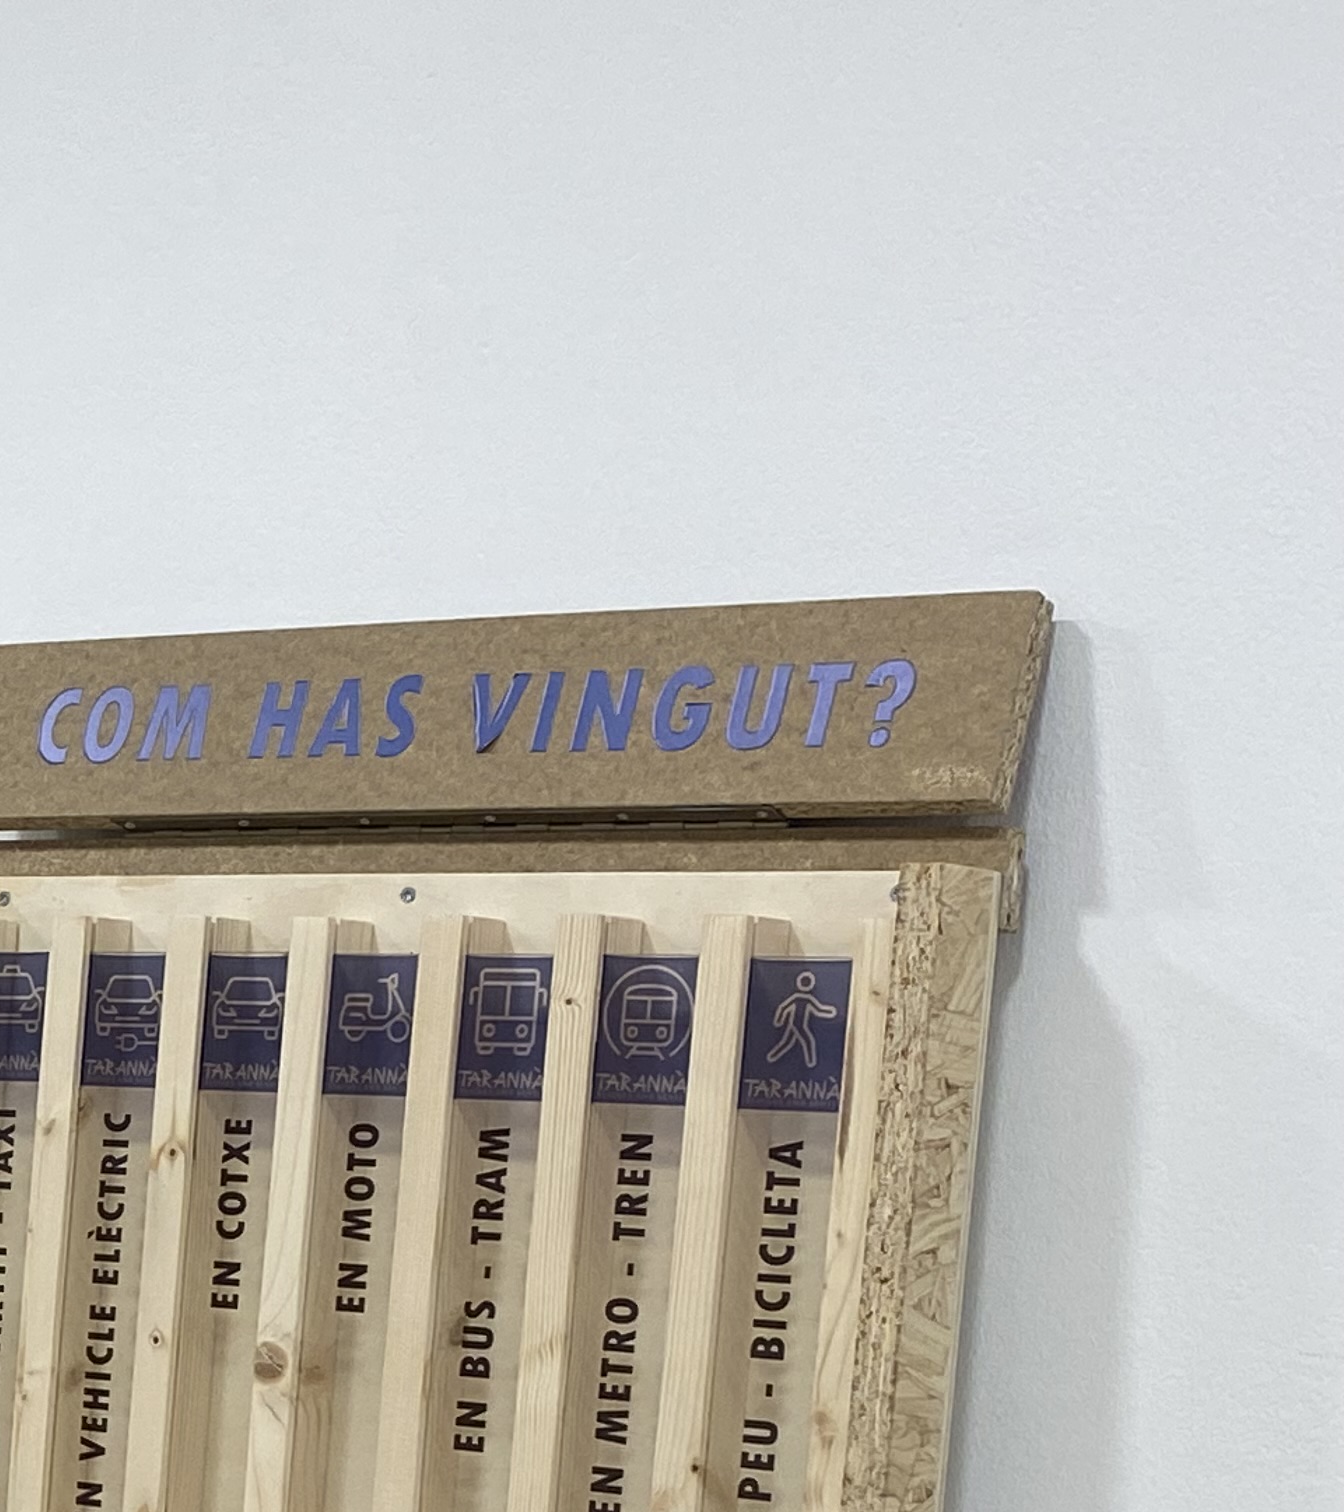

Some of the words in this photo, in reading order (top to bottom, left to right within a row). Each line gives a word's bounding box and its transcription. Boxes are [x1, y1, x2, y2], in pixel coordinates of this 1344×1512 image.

[35, 682, 214, 767] COM
[248, 671, 426, 761] HAS
[470, 656, 919, 755] VINGUT?
[743, 1076, 842, 1101] TARANNÀ
[86, 1111, 132, 1286] ELÈCTRIC
[215, 1117, 254, 1241] COTXE
[340, 1121, 381, 1242] MOTO
[470, 1126, 512, 1246] TRAM
[611, 1132, 654, 1243] TREN
[210, 1260, 242, 1310] EN
[335, 1263, 368, 1314] EN
[750, 1139, 806, 1362] BICICLETA
[80, 1306, 117, 1462] VEHICLE
[459, 1299, 497, 1380] BUS
[594, 1297, 640, 1447] METRO
[453, 1400, 488, 1454] EN
[737, 1419, 780, 1503] PEU
